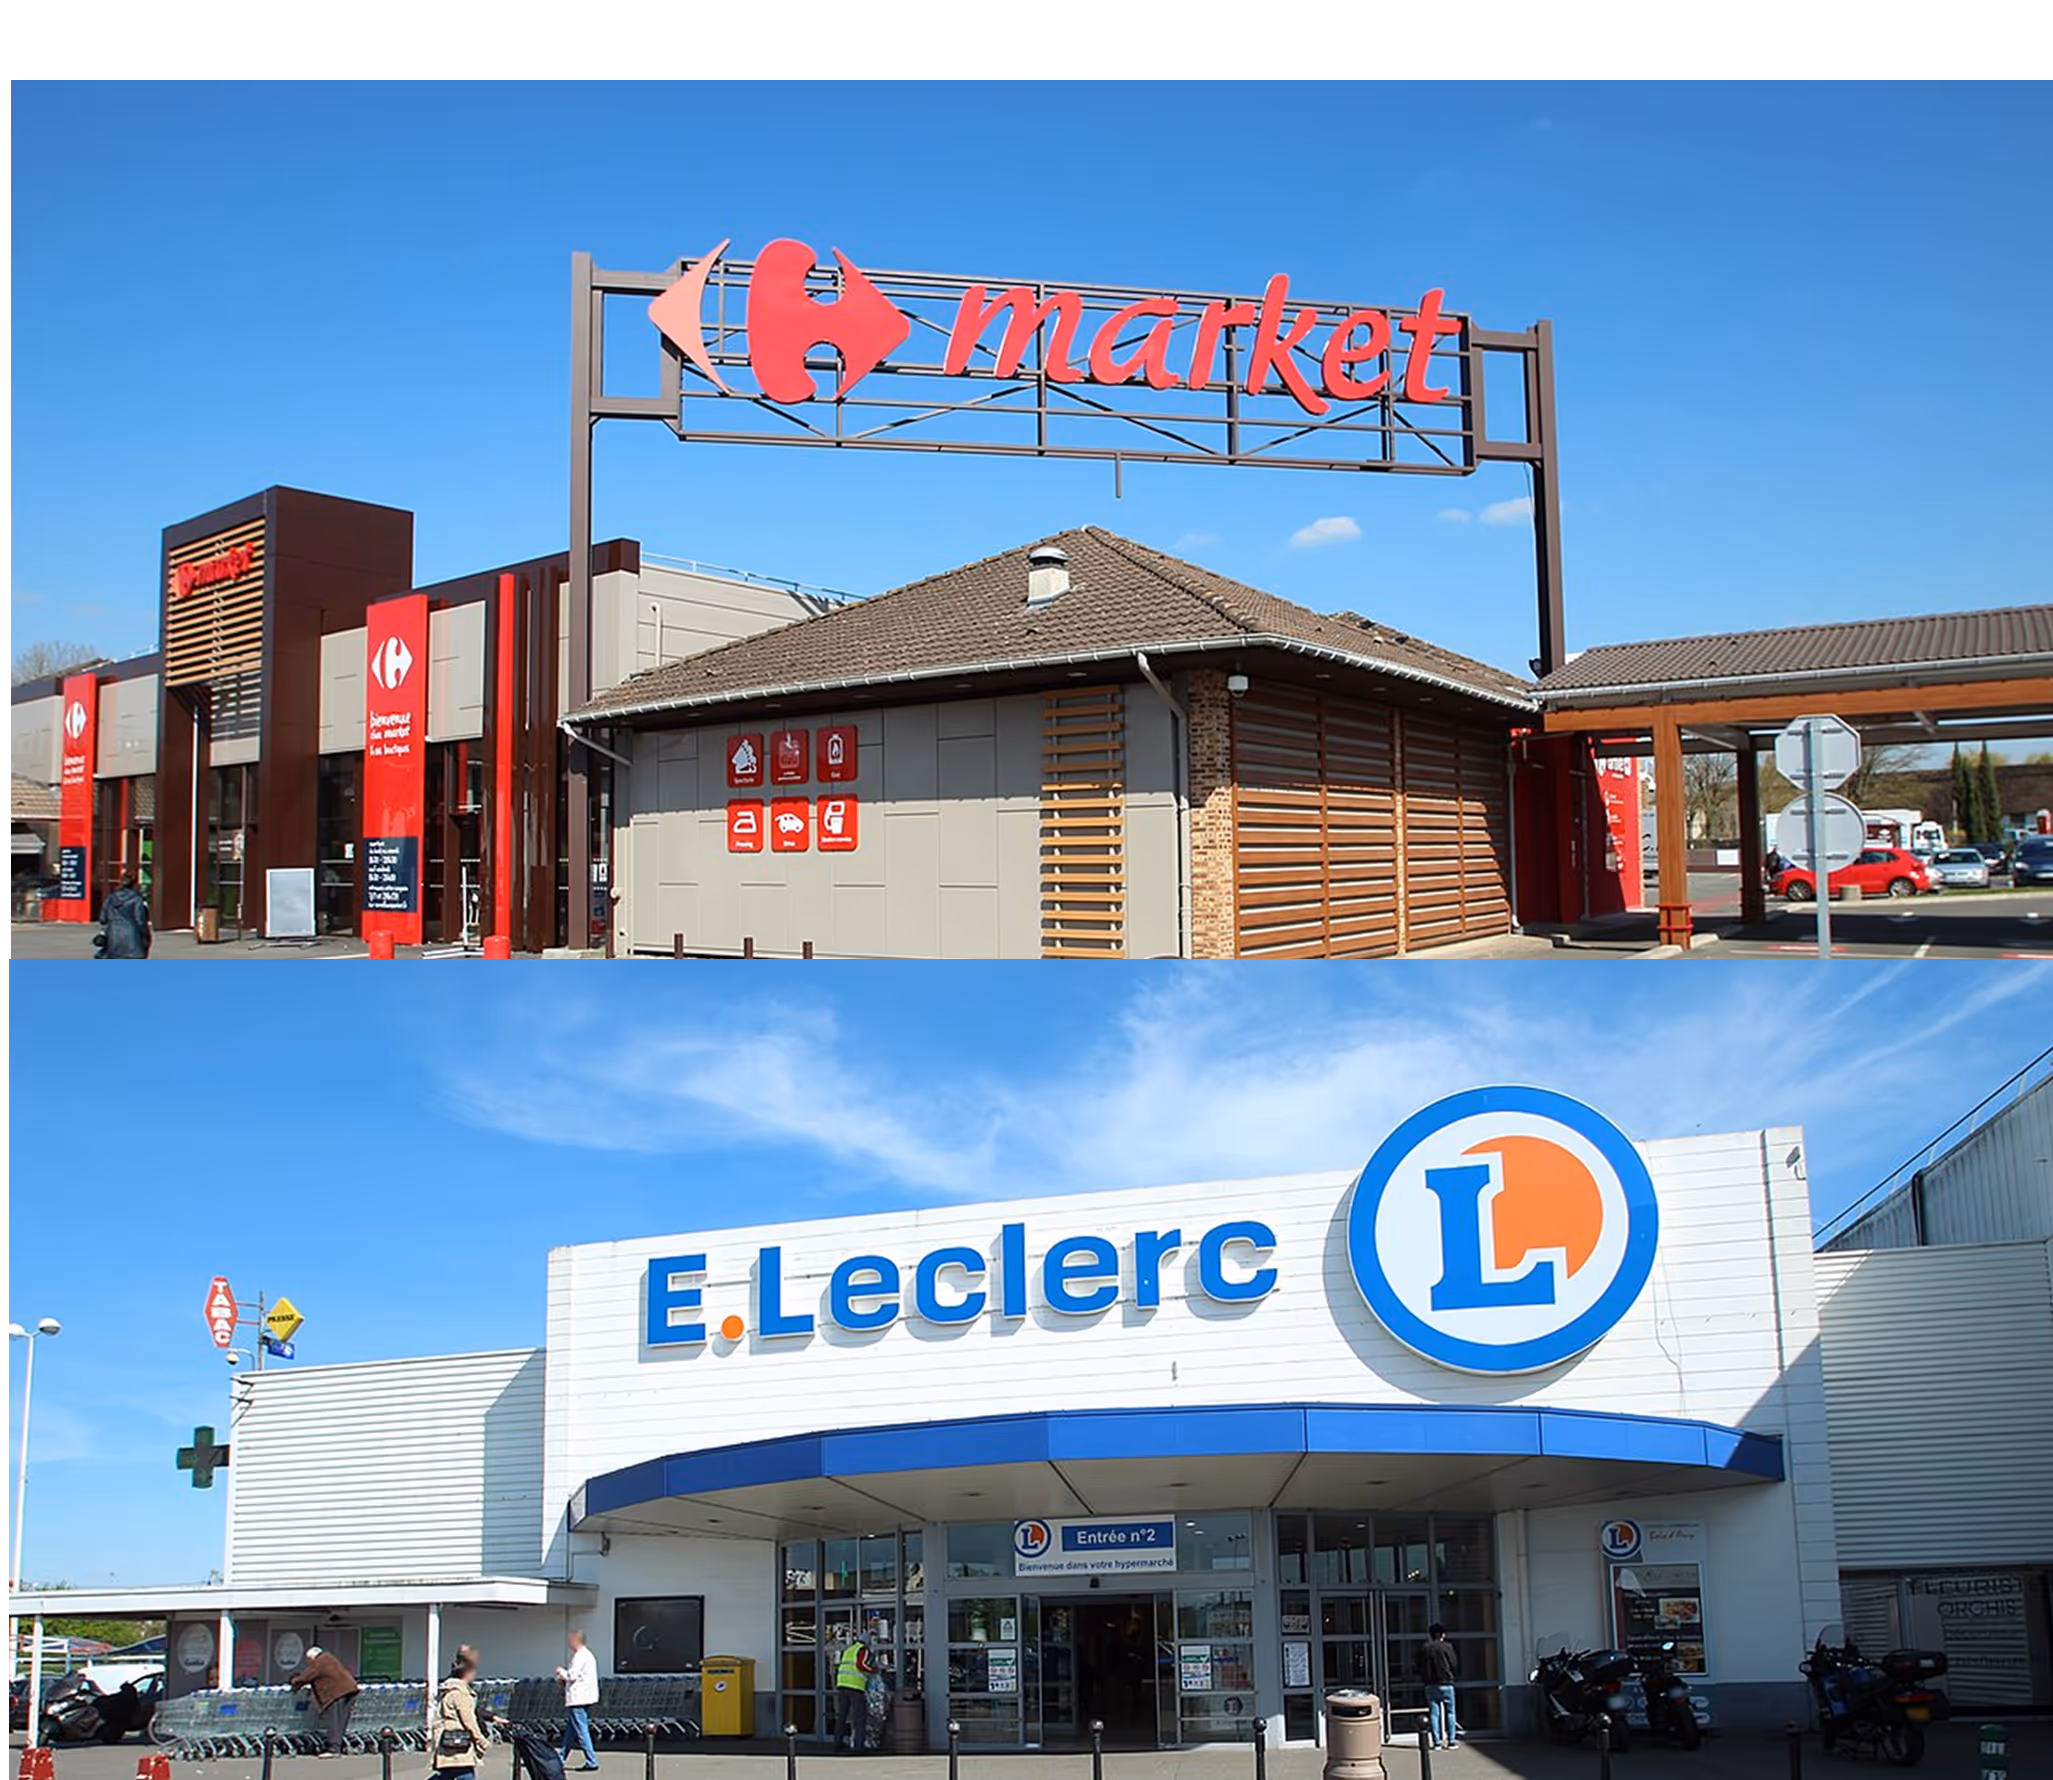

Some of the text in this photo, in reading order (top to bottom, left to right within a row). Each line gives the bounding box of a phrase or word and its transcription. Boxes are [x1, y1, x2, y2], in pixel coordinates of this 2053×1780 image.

[945, 275, 1461, 415] market
[211, 1281, 233, 1344] TABAC
[646, 1220, 1278, 1347] E.Leclerc
[1018, 1558, 1175, 1572] Bienvenue dans votre hypermarché
[1077, 1530, 1126, 1545] Entrée
[1130, 1528, 1157, 1543] n°2
